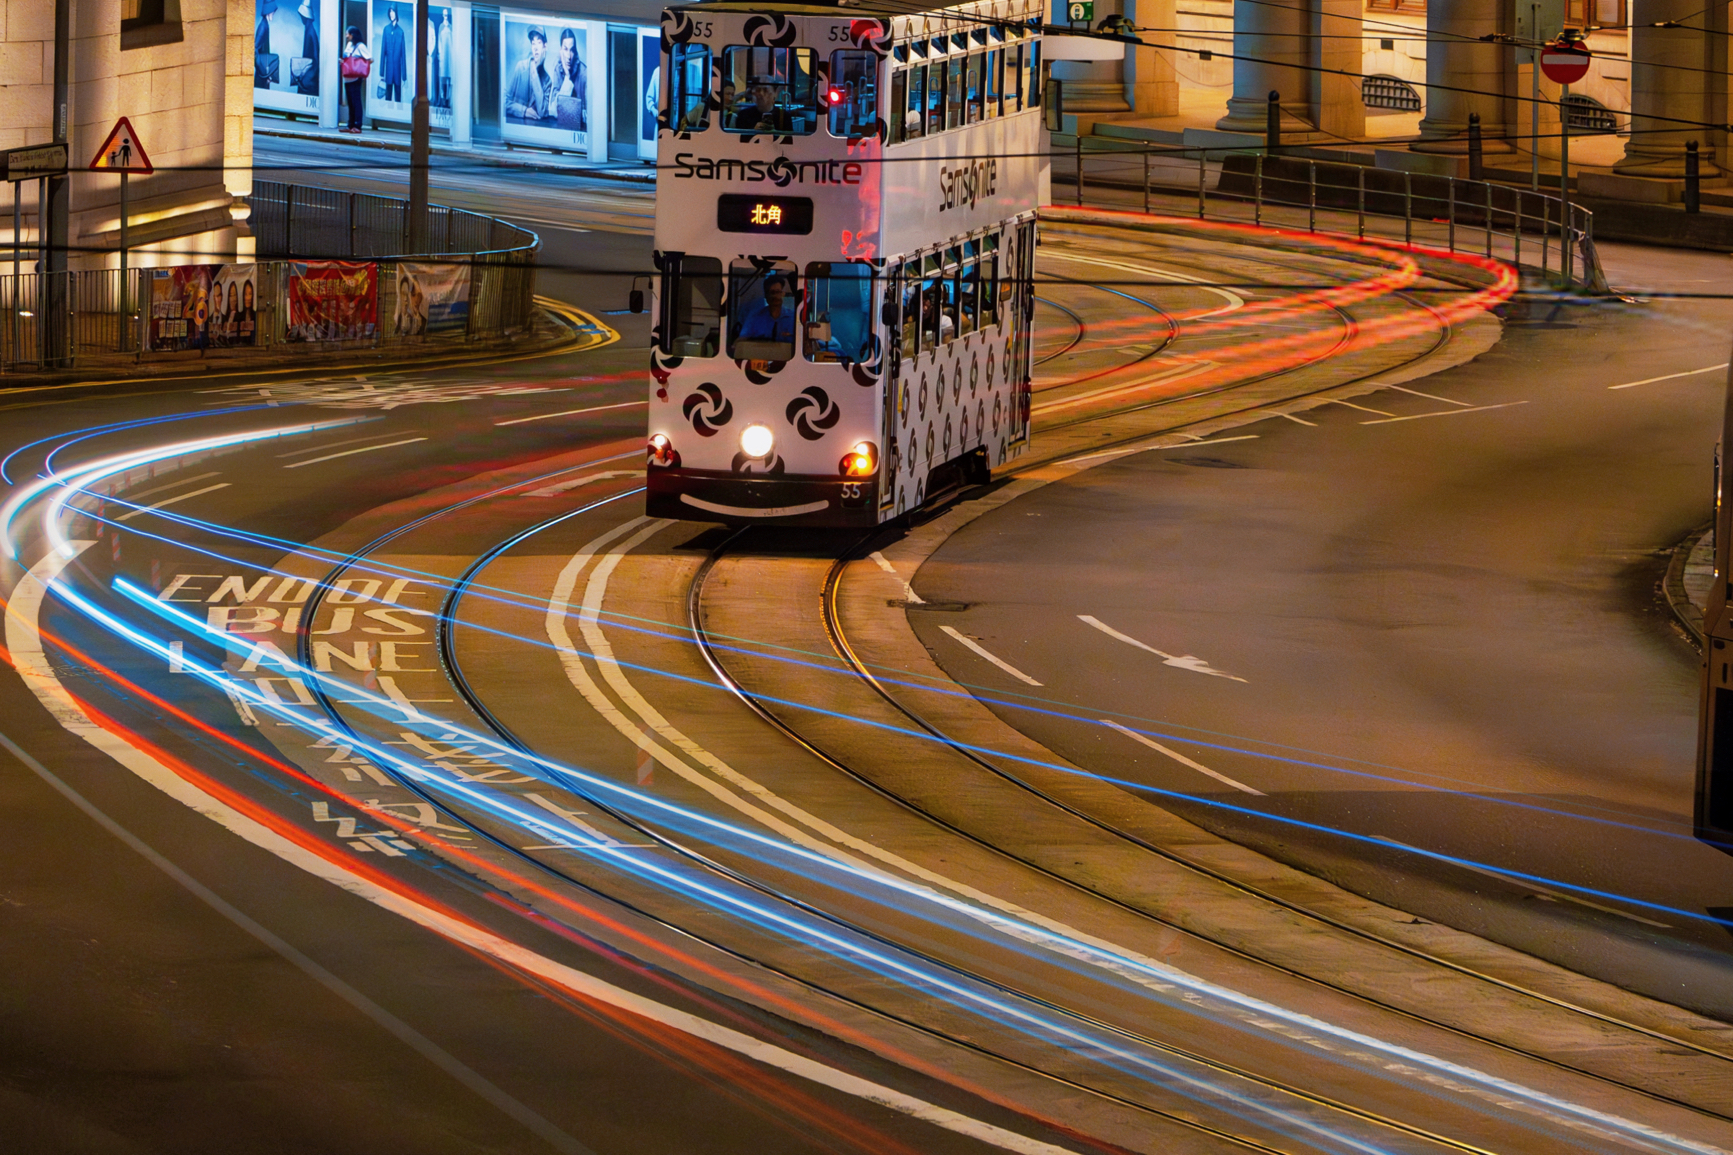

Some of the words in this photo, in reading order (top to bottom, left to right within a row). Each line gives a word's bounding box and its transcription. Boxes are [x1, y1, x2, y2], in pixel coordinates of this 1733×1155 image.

[693, 21, 713, 38] 55
[828, 25, 850, 42] 55
[674, 152, 862, 188] Samsonite
[939, 158, 996, 212] Samsonite
[751, 204, 782, 225] 北角
[840, 482, 861, 499] 55
[157, 574, 320, 604] END
[206, 606, 437, 635] BUS
[168, 640, 437, 674] LANE
